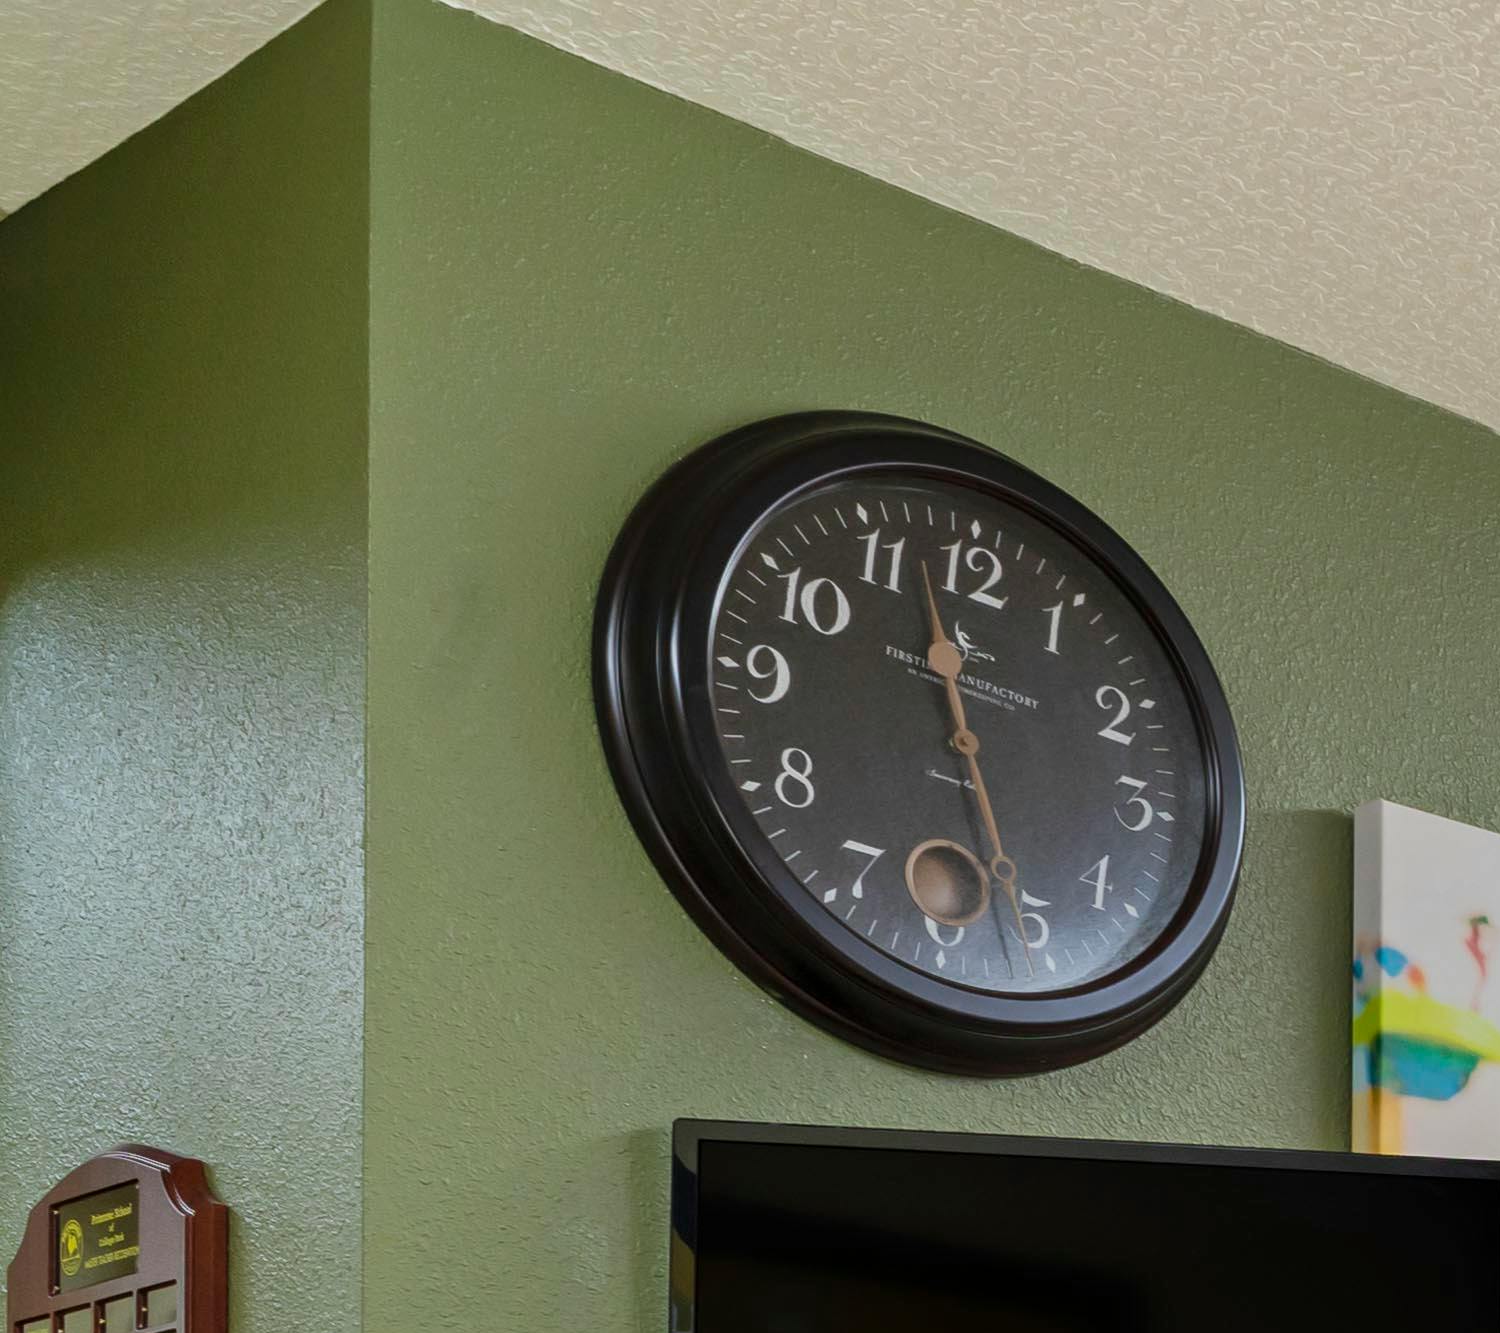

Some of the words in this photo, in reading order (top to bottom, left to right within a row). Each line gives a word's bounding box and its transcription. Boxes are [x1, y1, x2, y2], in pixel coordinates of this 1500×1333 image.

[857, 529, 905, 593] 11
[940, 539, 1009, 610] 12
[776, 566, 850, 635] 10
[1041, 600, 1065, 655] 1
[746, 644, 791, 703] 9
[954, 672, 1040, 709] ANUFACTORY
[1095, 684, 1136, 745] 2
[774, 748, 815, 808] 8
[1114, 776, 1153, 831] 3
[842, 838, 886, 898] 7
[1079, 855, 1114, 910] 4
[1007, 889, 1051, 948] 5
